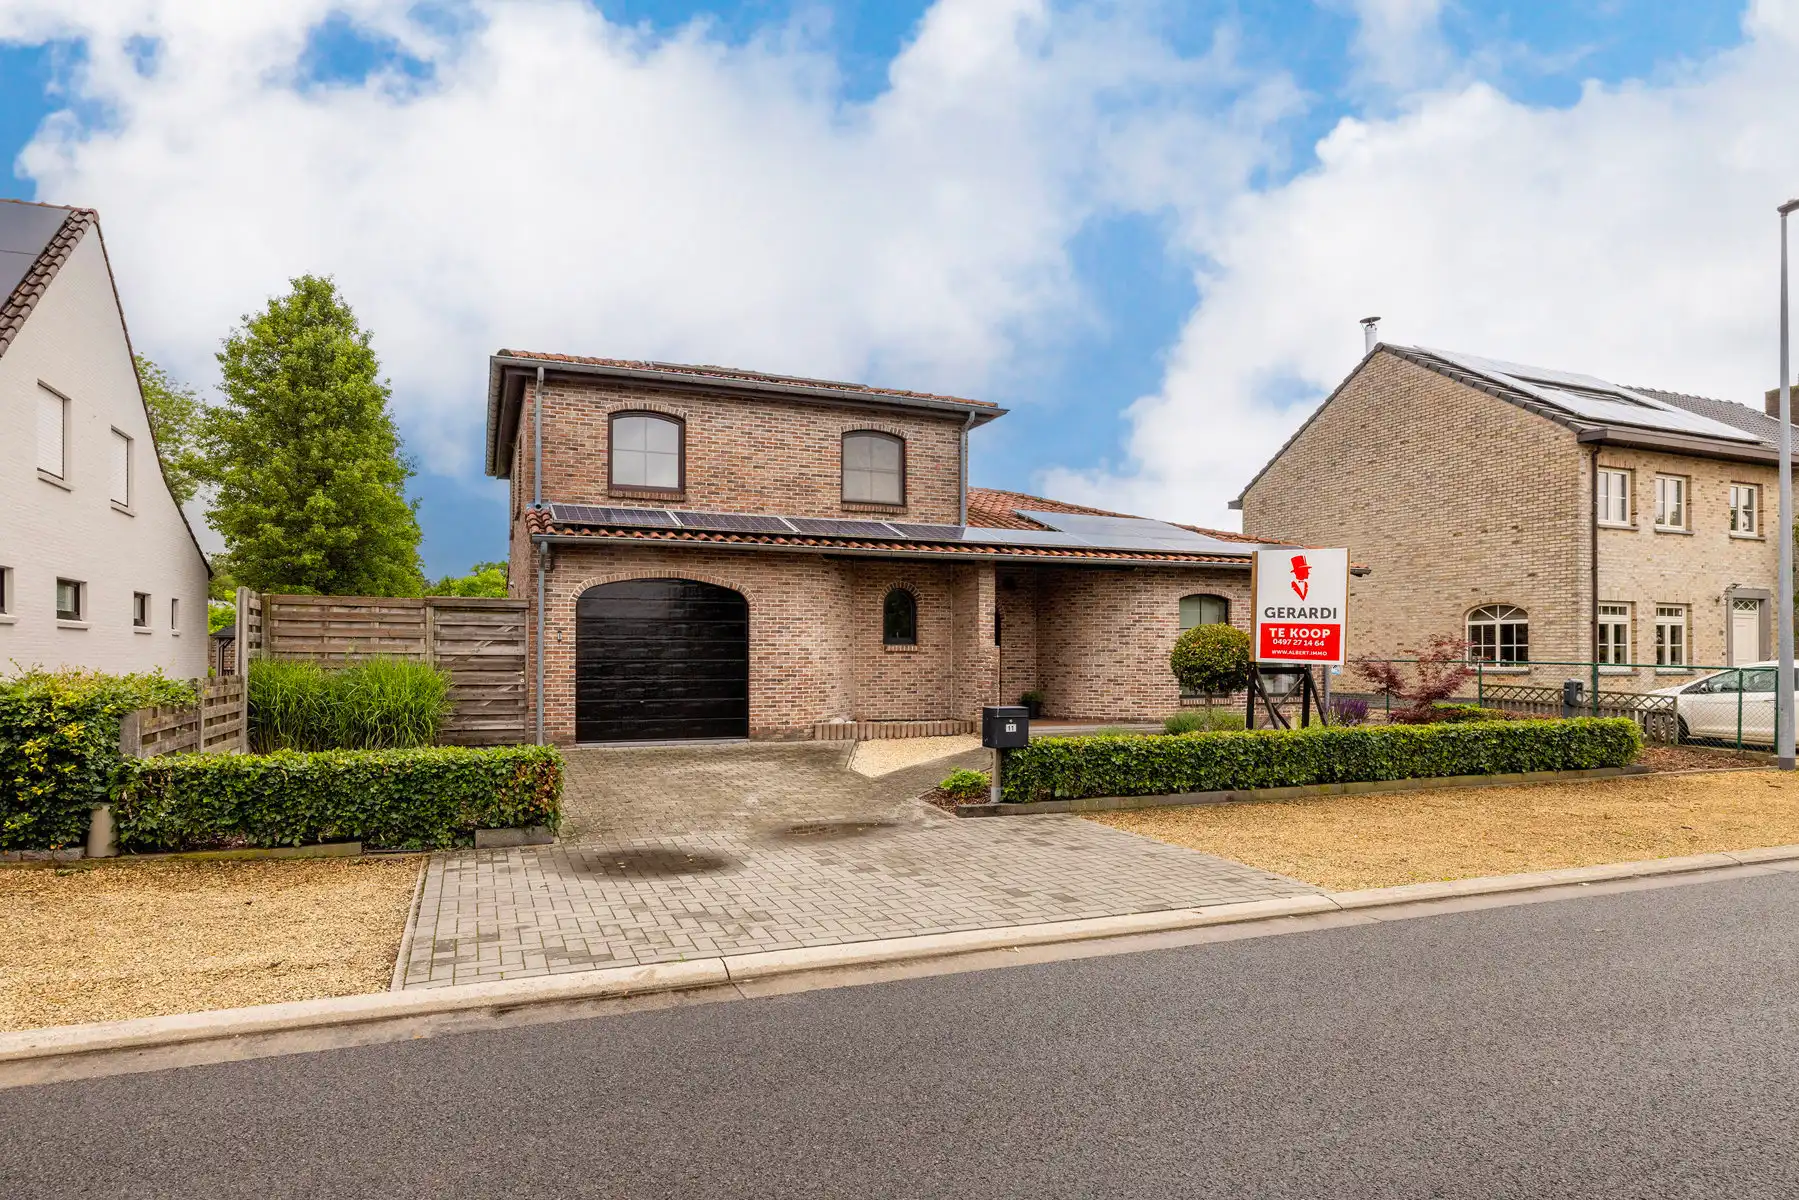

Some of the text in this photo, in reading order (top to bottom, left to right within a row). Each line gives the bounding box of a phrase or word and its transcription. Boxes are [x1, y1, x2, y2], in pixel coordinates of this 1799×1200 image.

[1264, 607, 1337, 619] GERARDI
[1269, 628, 1331, 638] TE KOOP
